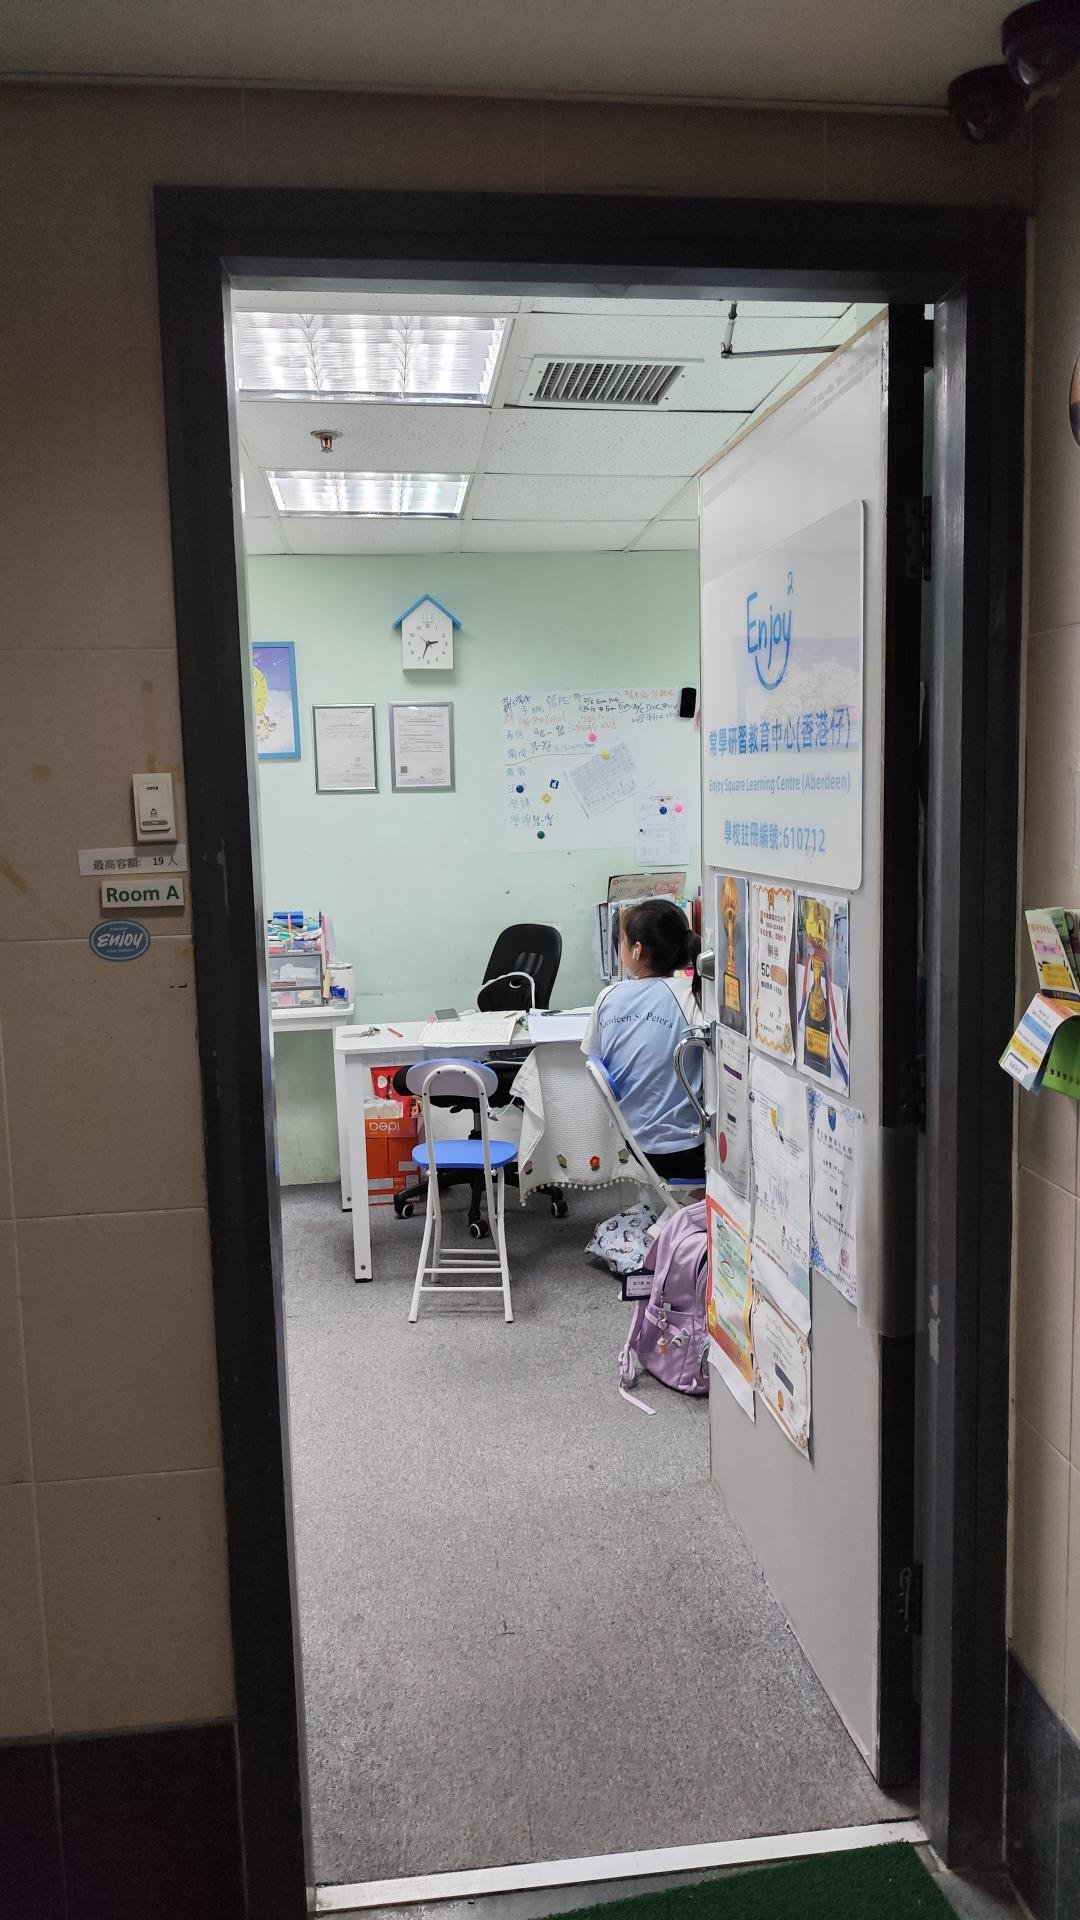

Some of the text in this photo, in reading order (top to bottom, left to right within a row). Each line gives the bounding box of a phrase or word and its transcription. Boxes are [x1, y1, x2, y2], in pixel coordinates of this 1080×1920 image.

[747, 591, 792, 690] Enjoy
[709, 770, 851, 796] Enjoy Square Learning Centre (Aberdeen)
[93, 855, 178, 871] 最高容額: 19 人
[106, 884, 180, 903] Room A
[761, 962, 770, 978] 5C
[646, 1011, 673, 1029] Peter's
